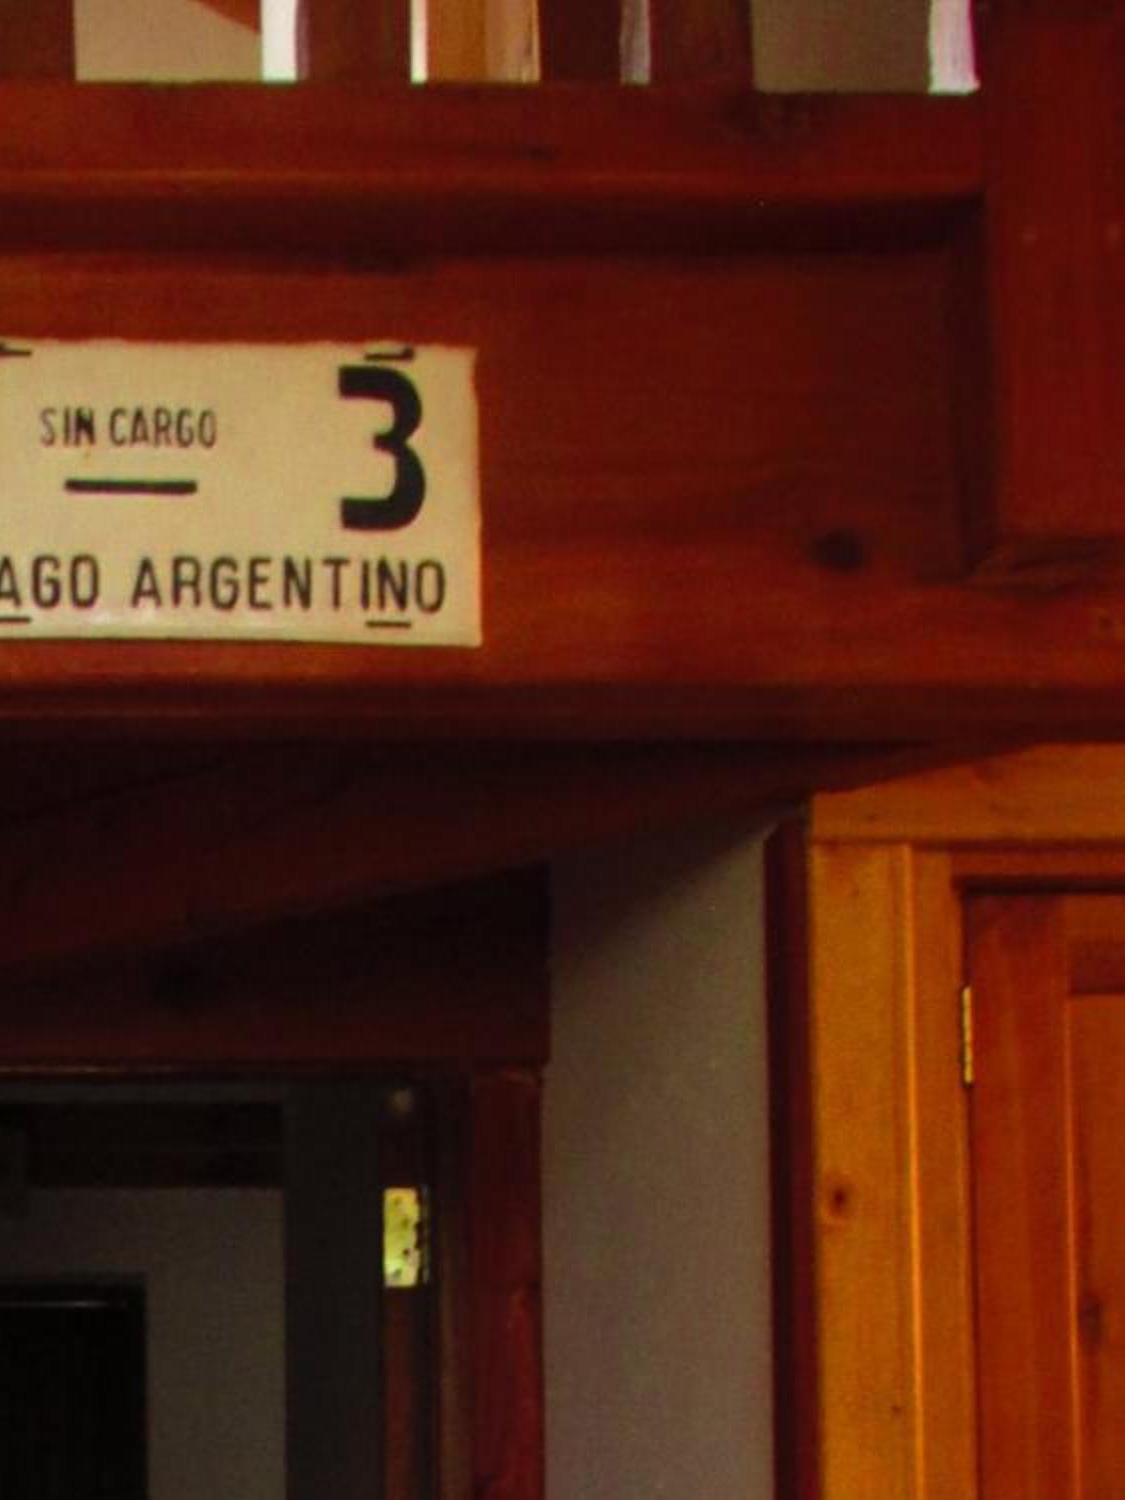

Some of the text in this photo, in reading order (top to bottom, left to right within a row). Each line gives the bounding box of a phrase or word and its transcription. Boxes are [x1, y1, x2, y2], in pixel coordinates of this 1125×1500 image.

[41, 406, 217, 450] SIN CARGO
[338, 365, 426, 531] 3
[131, 556, 446, 613] ARGENTINO
